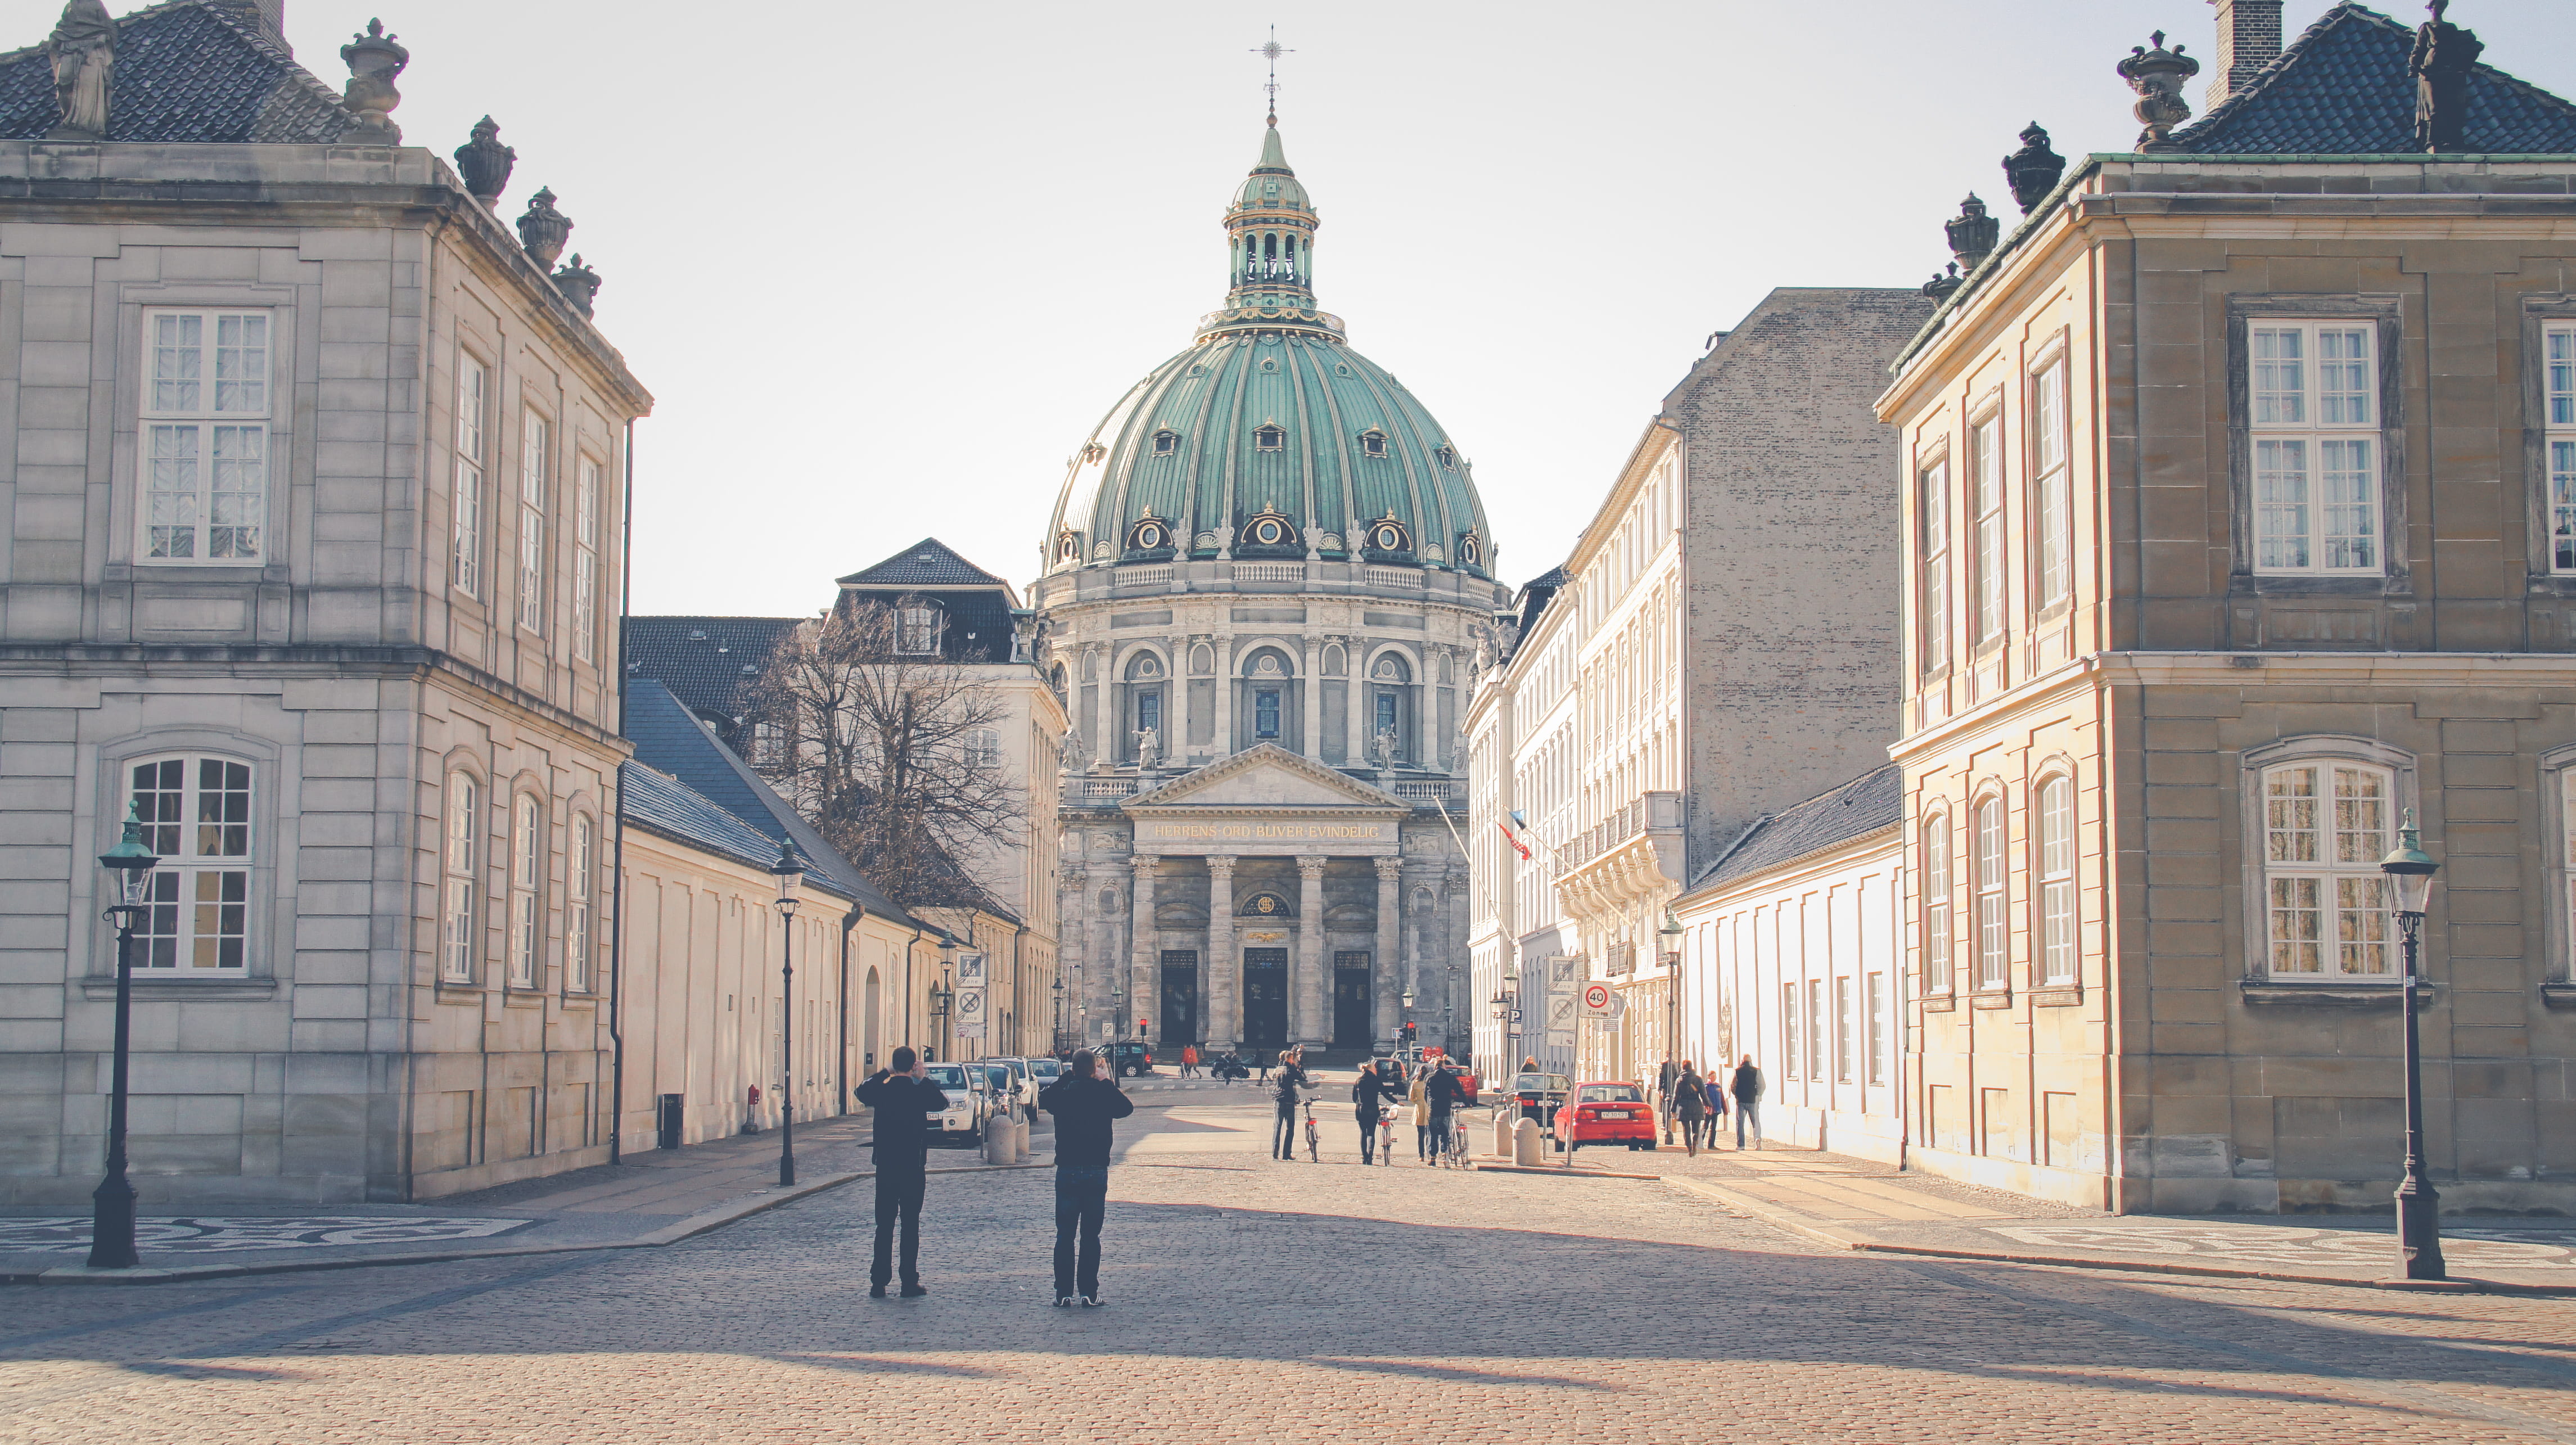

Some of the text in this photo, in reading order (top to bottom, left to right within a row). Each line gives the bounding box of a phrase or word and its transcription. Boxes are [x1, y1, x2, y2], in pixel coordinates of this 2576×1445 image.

[1156, 826, 1378, 837] HERRENS ORD BLIVER EVINDELIG
[1590, 992, 1603, 1001] 40
[1510, 1010, 1520, 1022] P
